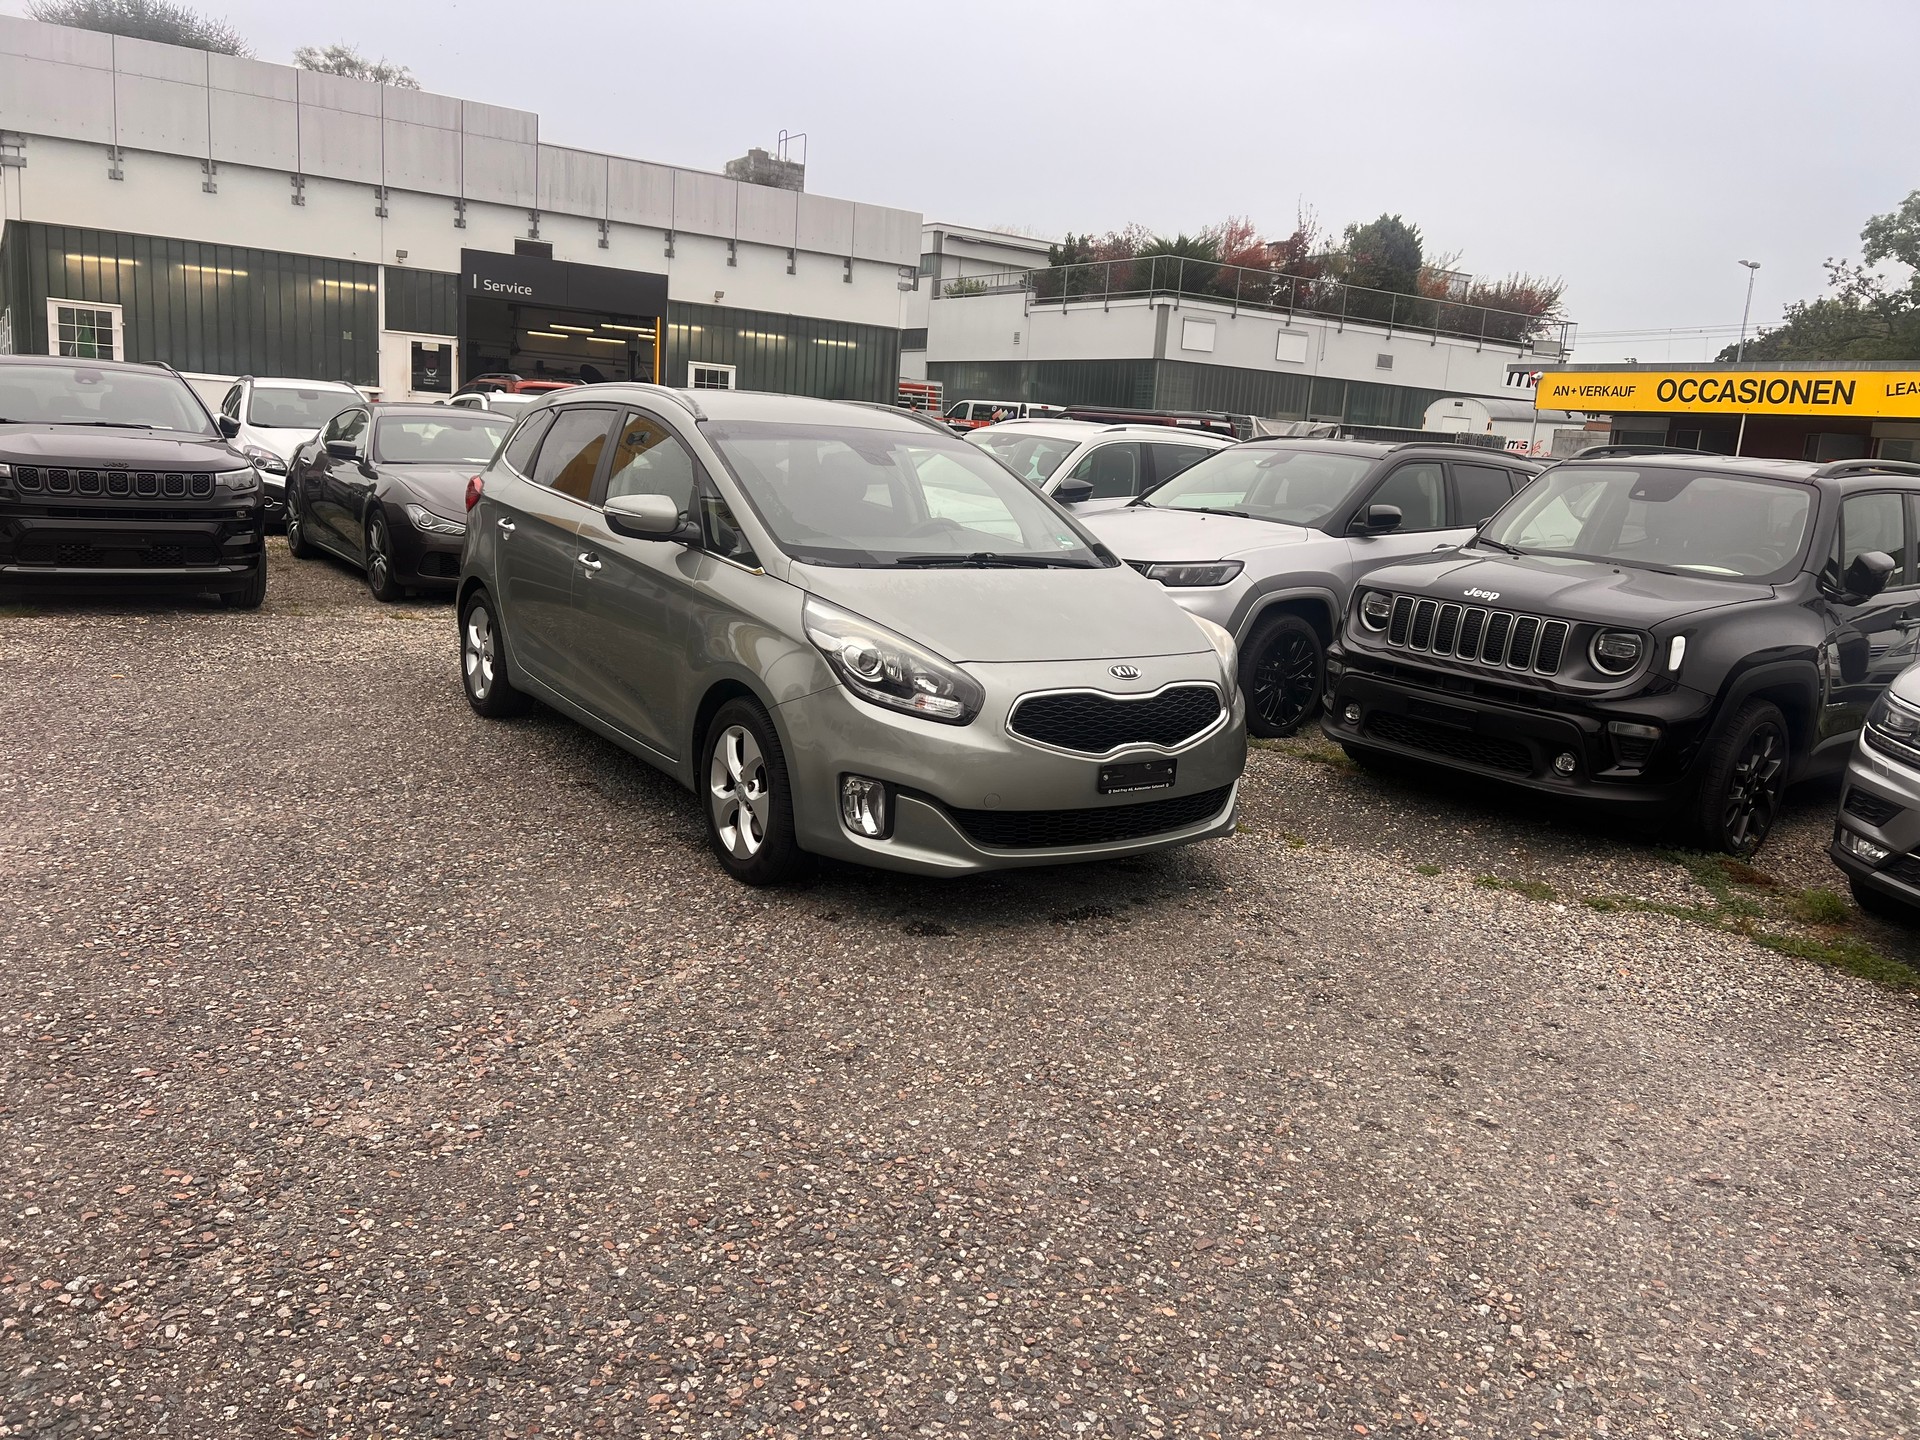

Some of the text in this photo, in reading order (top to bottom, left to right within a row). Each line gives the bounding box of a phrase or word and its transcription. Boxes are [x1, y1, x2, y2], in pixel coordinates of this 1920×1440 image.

[483, 279, 533, 296] Service
[1656, 378, 1857, 404] OCCASIONEN
[1886, 381, 1920, 397] LEA
[1463, 587, 1501, 602] Jeep
[1111, 666, 1141, 677] KIA
